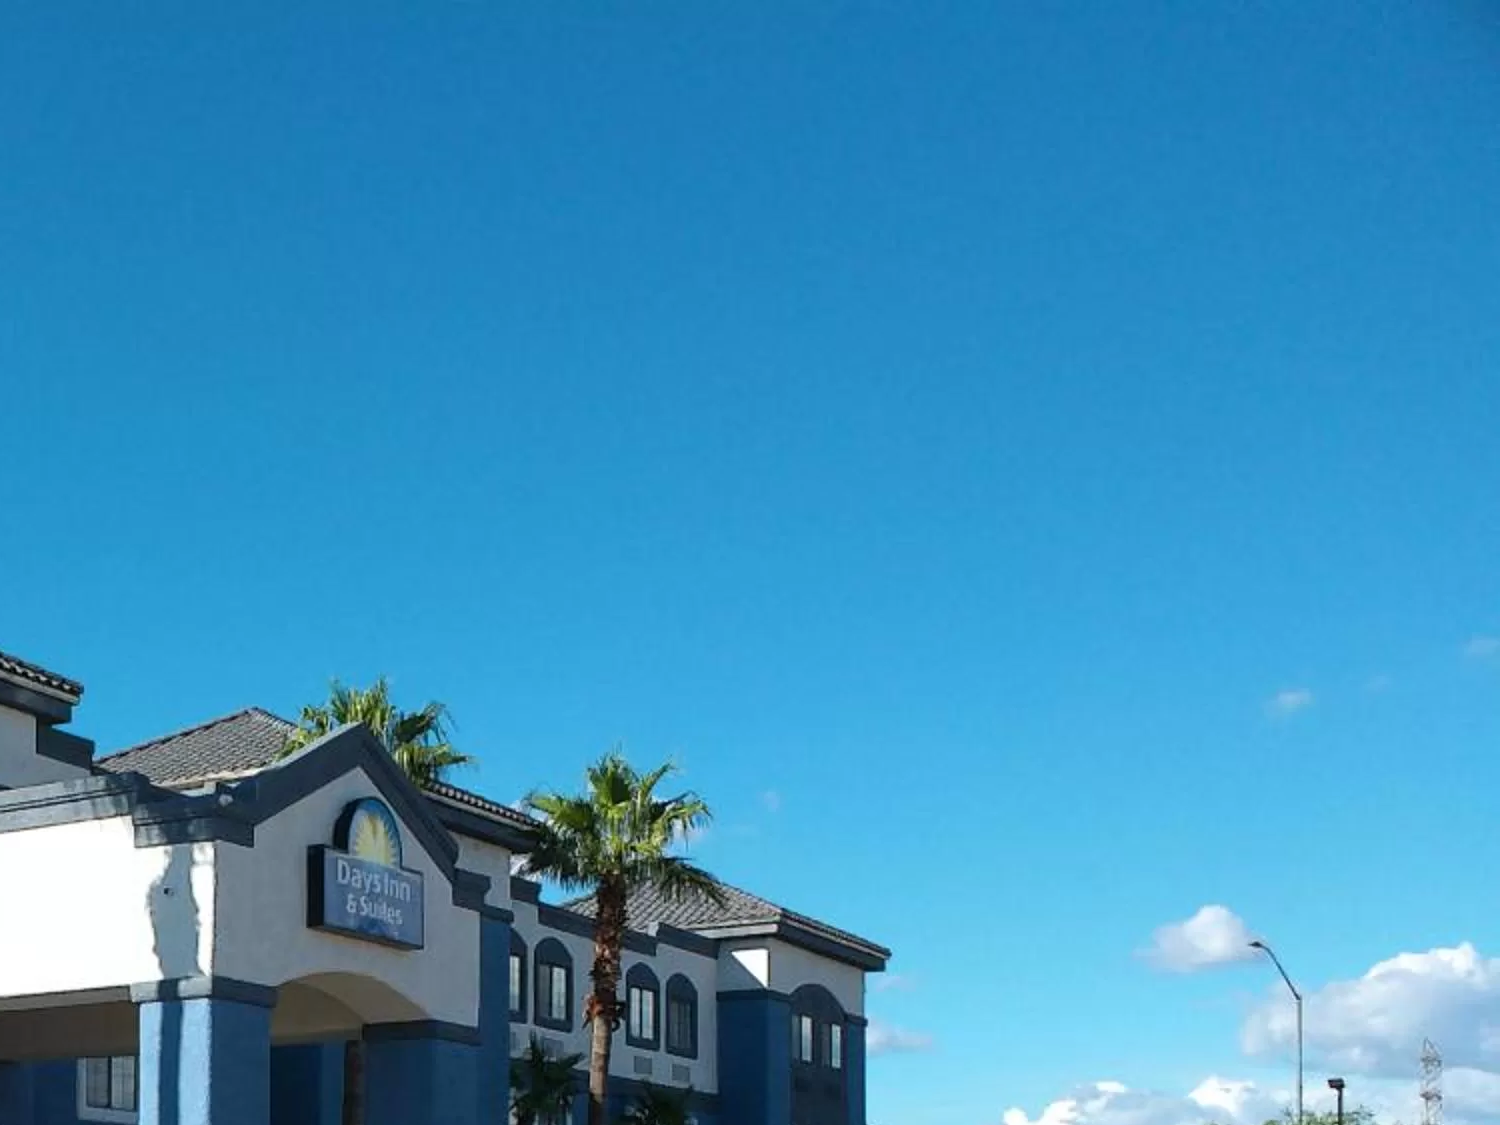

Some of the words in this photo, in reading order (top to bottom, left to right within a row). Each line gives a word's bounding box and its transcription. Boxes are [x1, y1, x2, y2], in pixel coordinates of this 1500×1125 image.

[337, 859, 381, 894] Days
[383, 873, 412, 902] Inn
[346, 893, 357, 914] &
[359, 896, 403, 925] Suites
